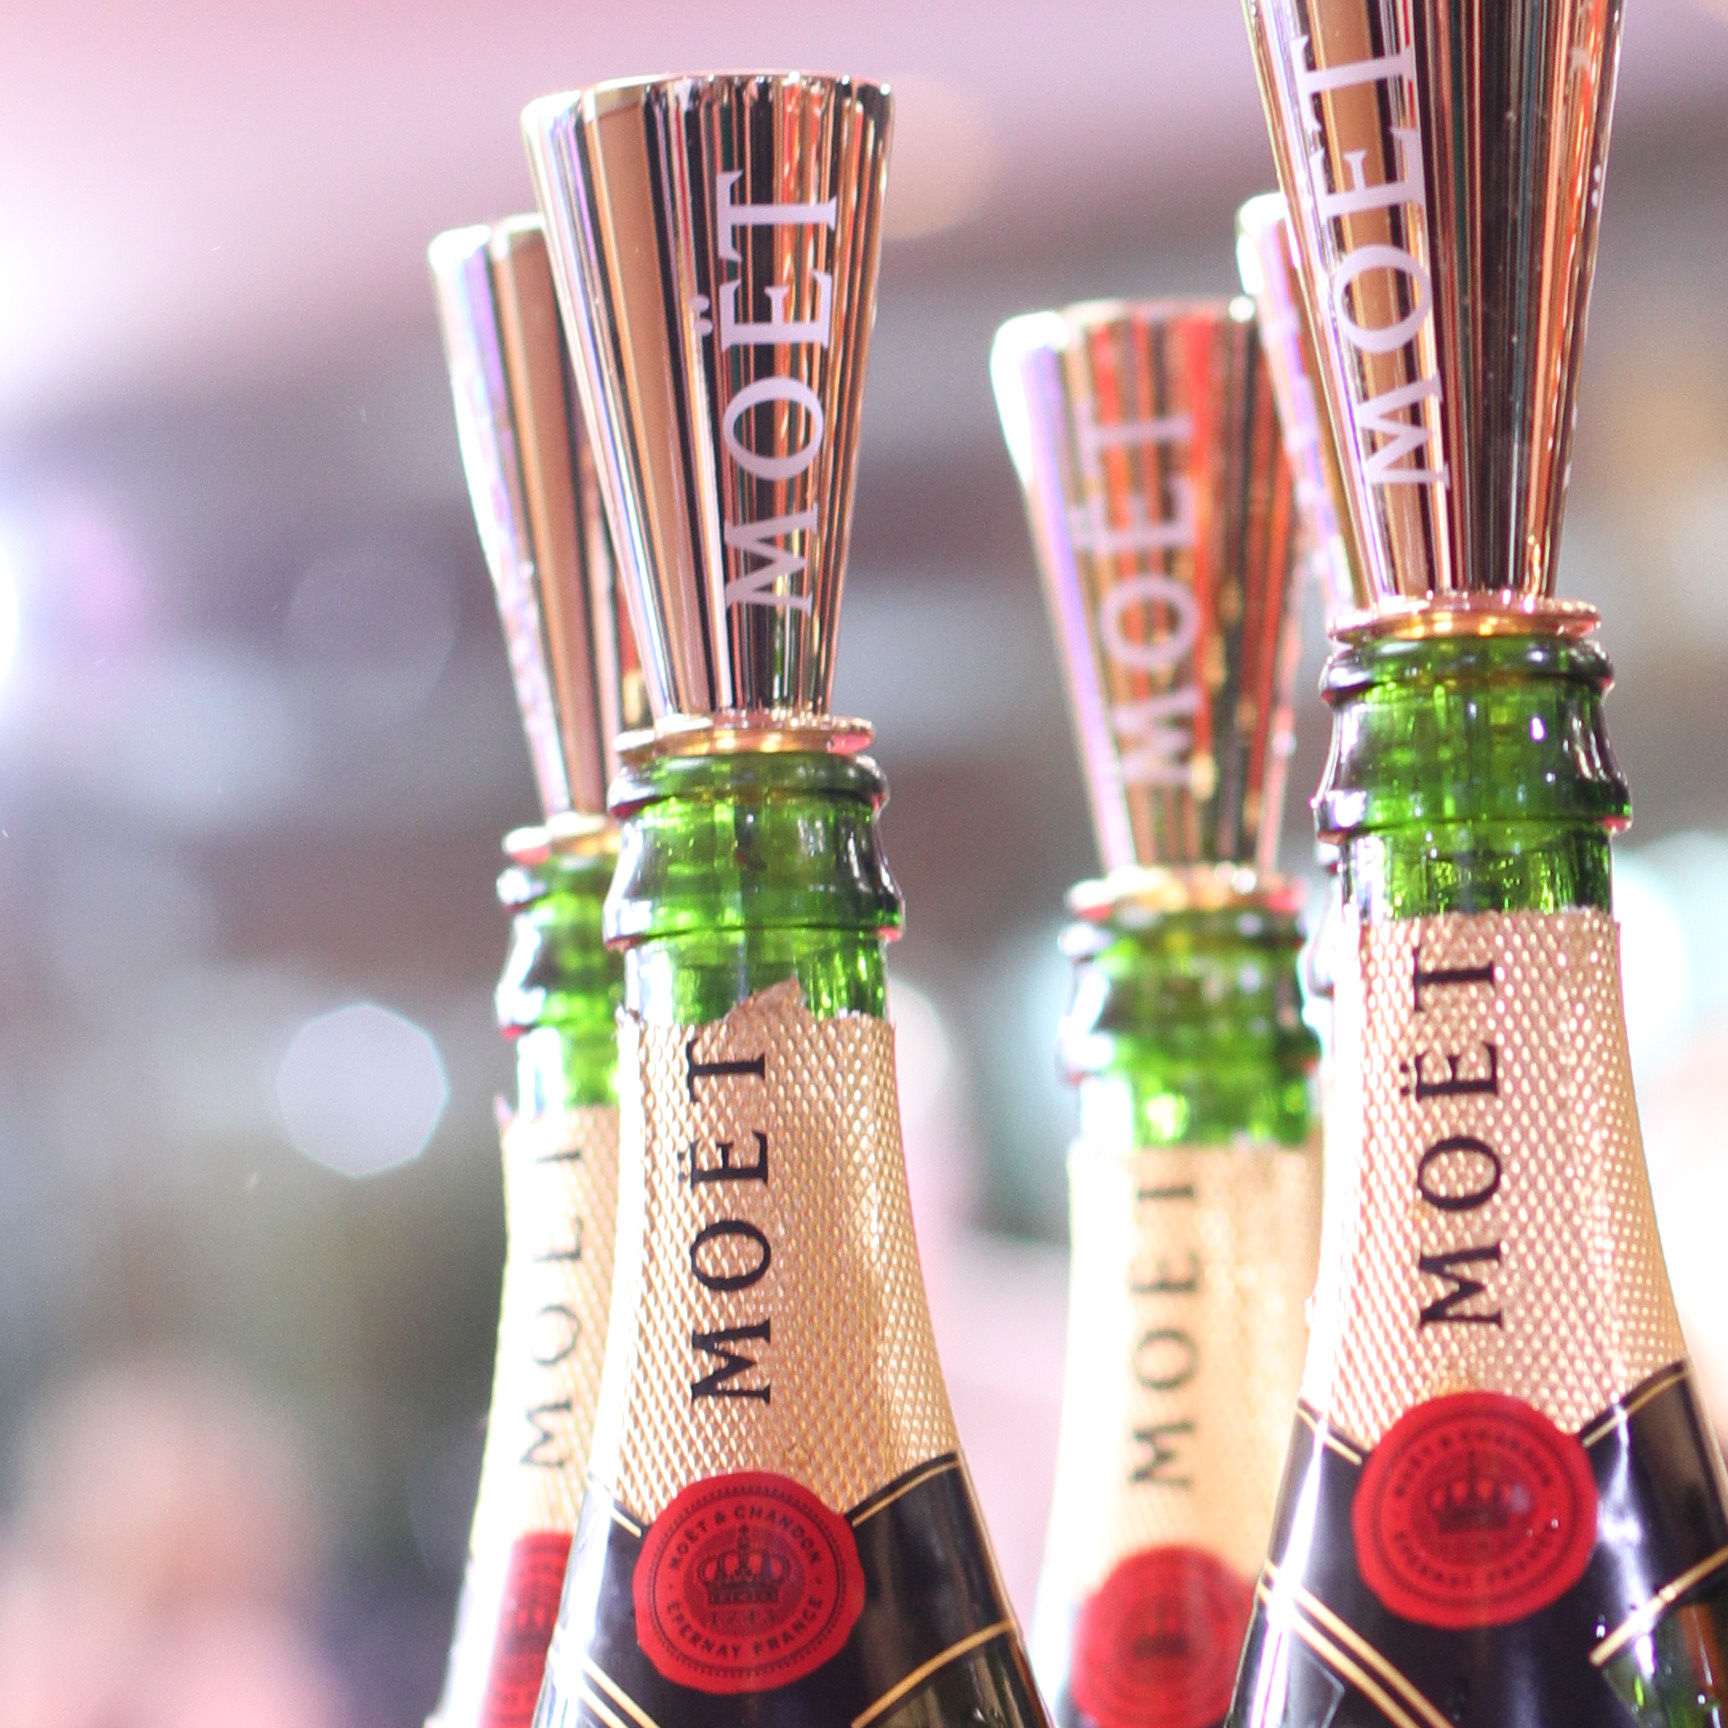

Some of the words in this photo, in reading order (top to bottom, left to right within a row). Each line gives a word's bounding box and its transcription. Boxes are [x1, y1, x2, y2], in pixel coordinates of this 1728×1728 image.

[690, 170, 837, 617] MOËT
[676, 1037, 771, 1404] MOËT
[1400, 946, 1503, 1328] MOËT
